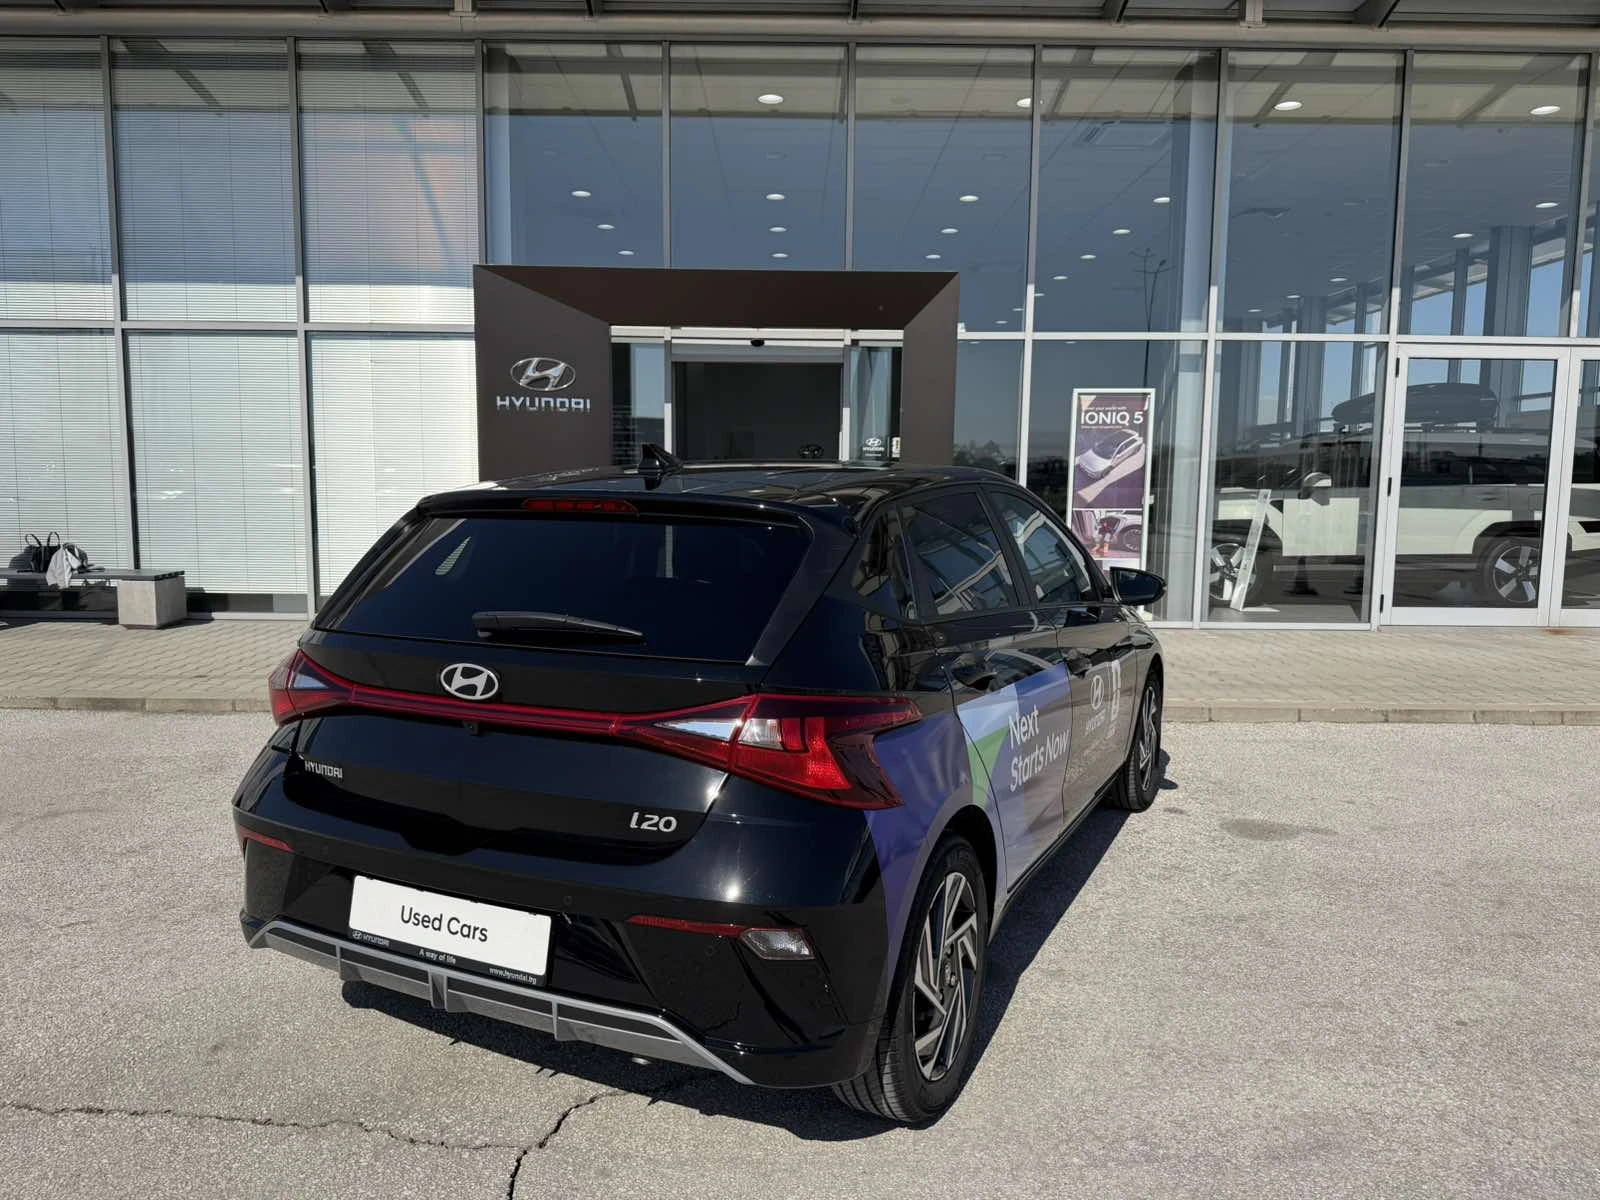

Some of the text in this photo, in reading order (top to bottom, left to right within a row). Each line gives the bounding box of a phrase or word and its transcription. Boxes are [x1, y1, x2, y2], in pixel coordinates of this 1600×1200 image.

[496, 396, 591, 410] HYUNDAI
[1080, 411, 1144, 426] IONIQ 5
[1008, 704, 1040, 750] Next
[304, 760, 343, 779] HYUNDAI
[1010, 744, 1045, 792] Starts
[1044, 729, 1070, 767] Now
[401, 905, 488, 942] Used Cars
[419, 948, 425, 957] A
[426, 951, 438, 961] way
[438, 953, 446, 962] of
